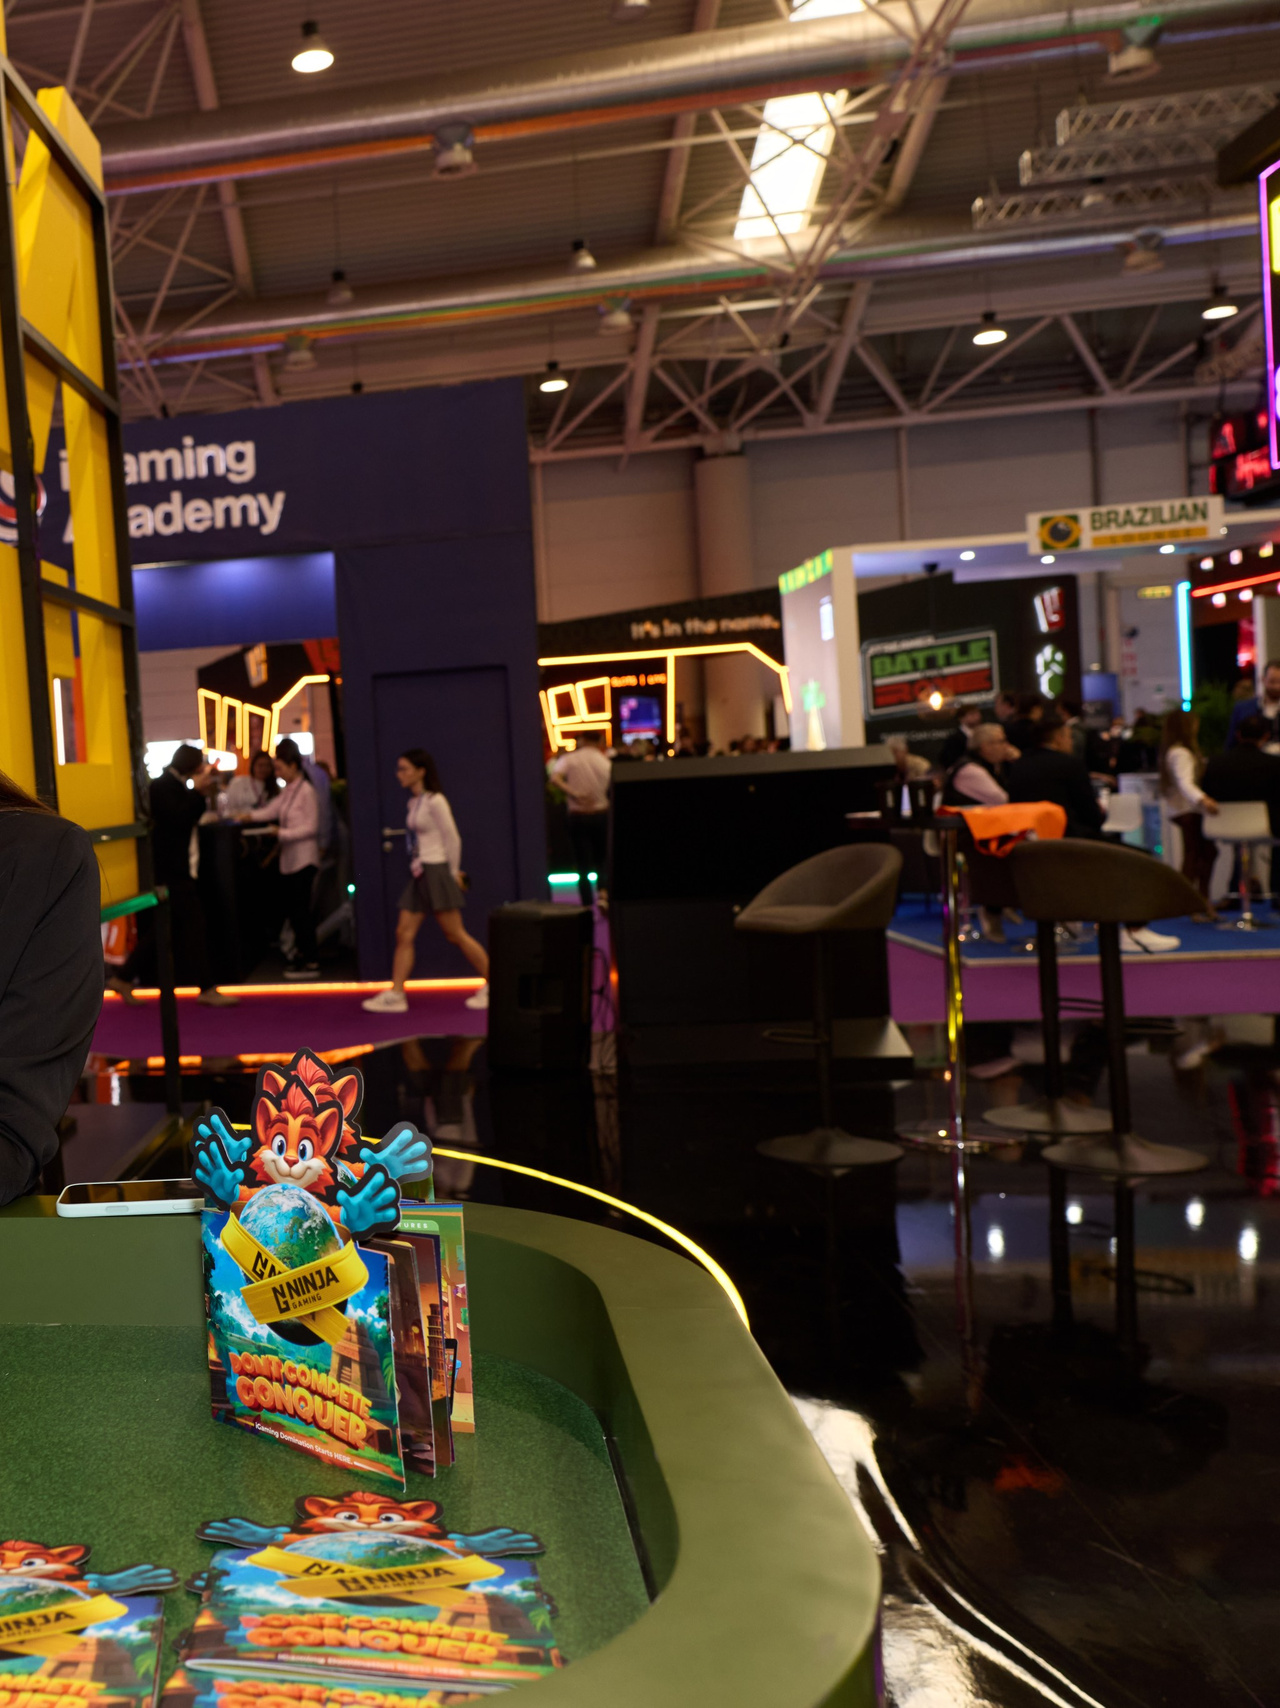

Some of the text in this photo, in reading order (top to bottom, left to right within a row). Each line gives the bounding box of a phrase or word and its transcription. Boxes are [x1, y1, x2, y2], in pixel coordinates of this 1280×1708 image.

[59, 436, 256, 484] iaming
[63, 491, 285, 541] ademy
[1090, 502, 1208, 531] BRAZILIAN
[662, 617, 683, 637] in
[685, 617, 718, 635] the
[872, 639, 990, 679] BATTLE
[285, 1266, 340, 1300] NINJA
[291, 1293, 322, 1309] GAMING
[284, 1359, 373, 1421] COMPETE
[236, 1375, 367, 1451] CONQUER
[280, 1431, 315, 1451] Domination
[315, 1444, 334, 1458] Starts
[363, 1566, 454, 1587] NINJA
[245, 1625, 498, 1665] CONQUER
[347, 1614, 508, 1646] COMPETE
